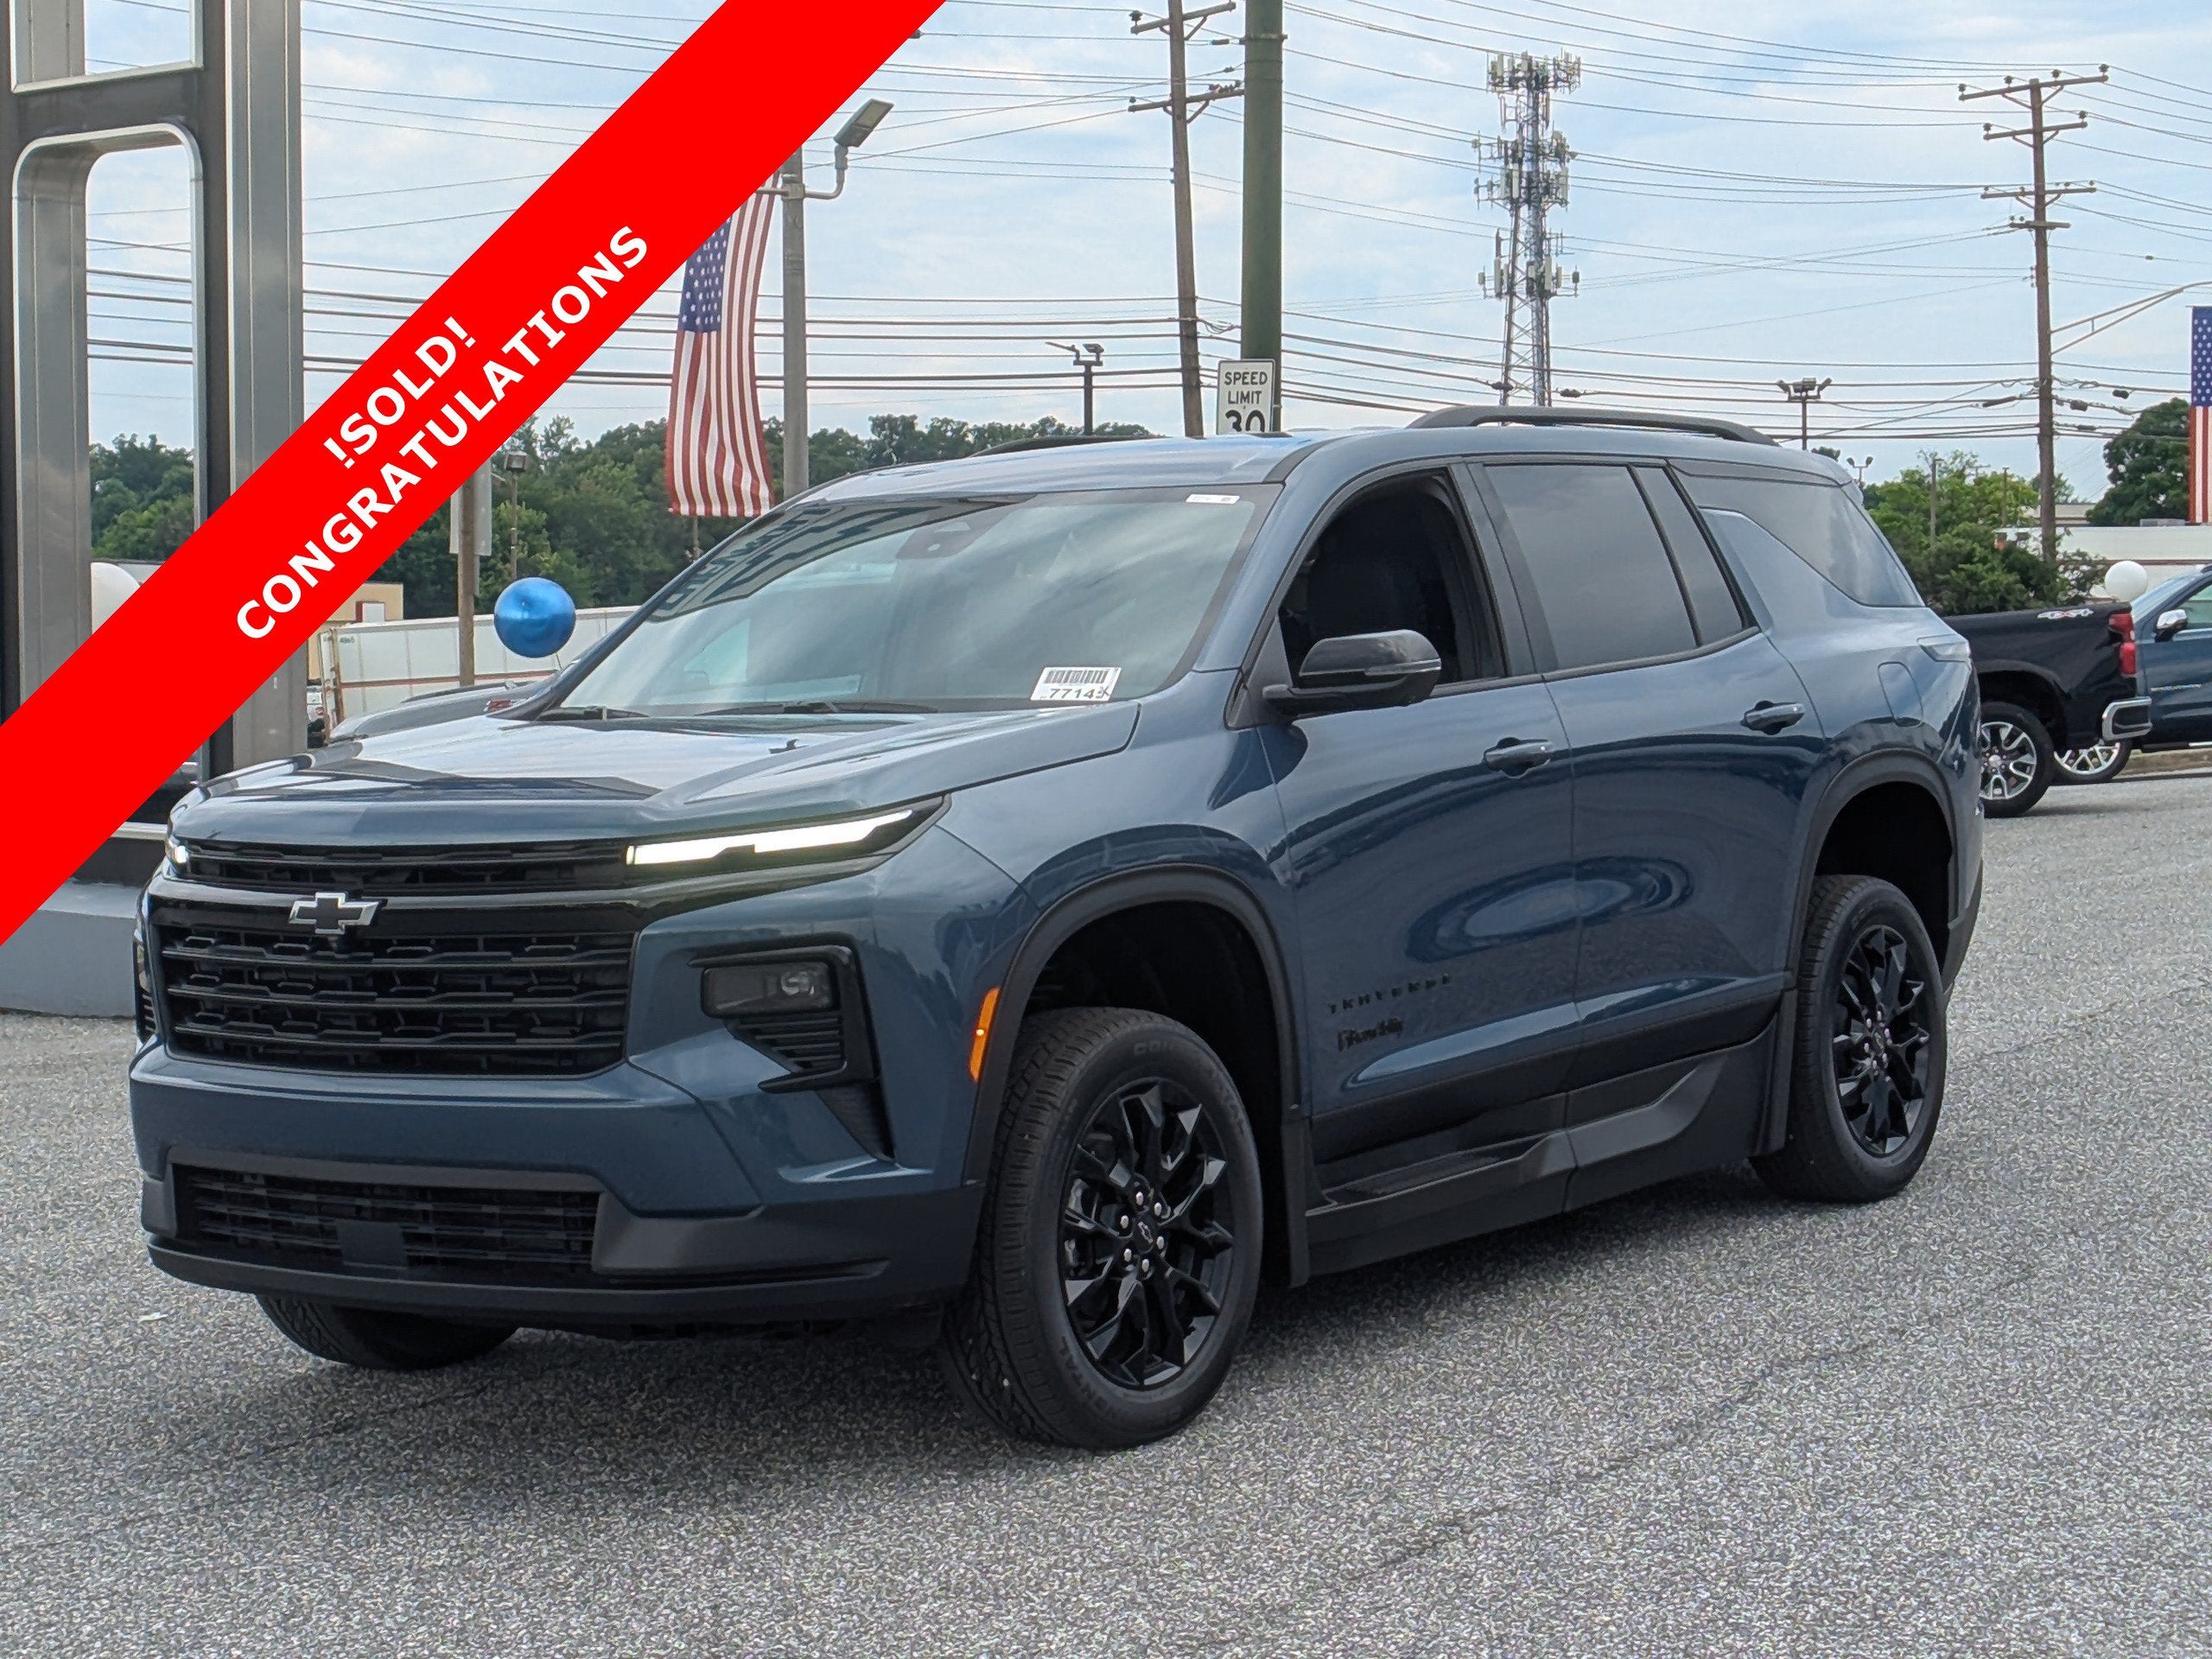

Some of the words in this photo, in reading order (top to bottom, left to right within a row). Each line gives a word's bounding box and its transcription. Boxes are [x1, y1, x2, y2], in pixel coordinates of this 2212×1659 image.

[1224, 372, 1268, 385] SPEED
[1228, 391, 1262, 404] LIMIT
[1225, 410, 1266, 432] 30
